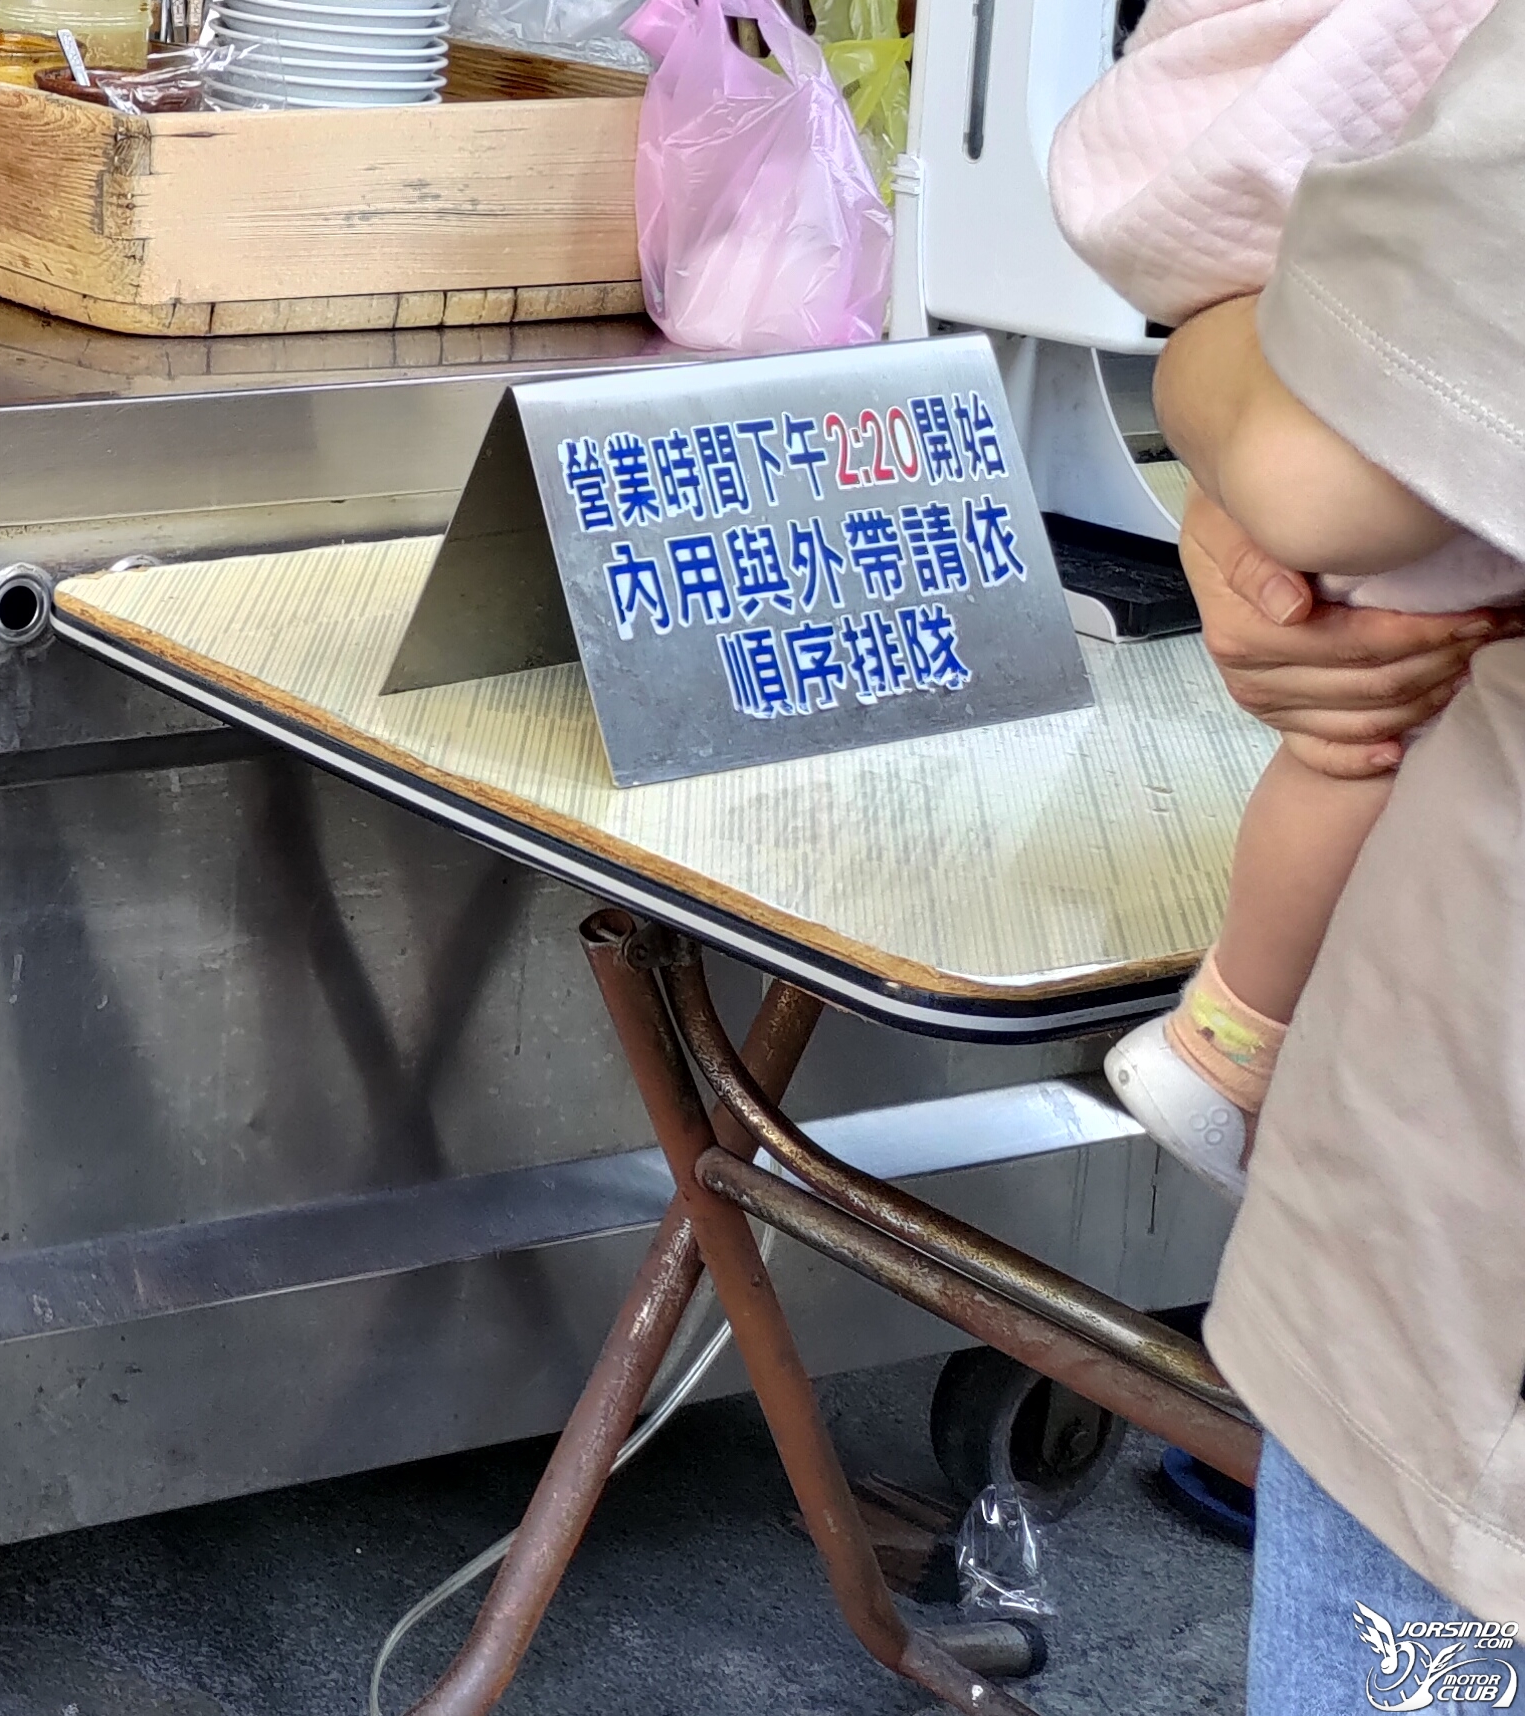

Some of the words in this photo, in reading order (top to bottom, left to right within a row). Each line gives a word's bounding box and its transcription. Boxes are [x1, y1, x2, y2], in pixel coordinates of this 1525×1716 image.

[557, 389, 1011, 534] 營業時間下午2:20開始
[604, 493, 1028, 642] 內用與外帶請依
[716, 601, 972, 719] 順序排隊
